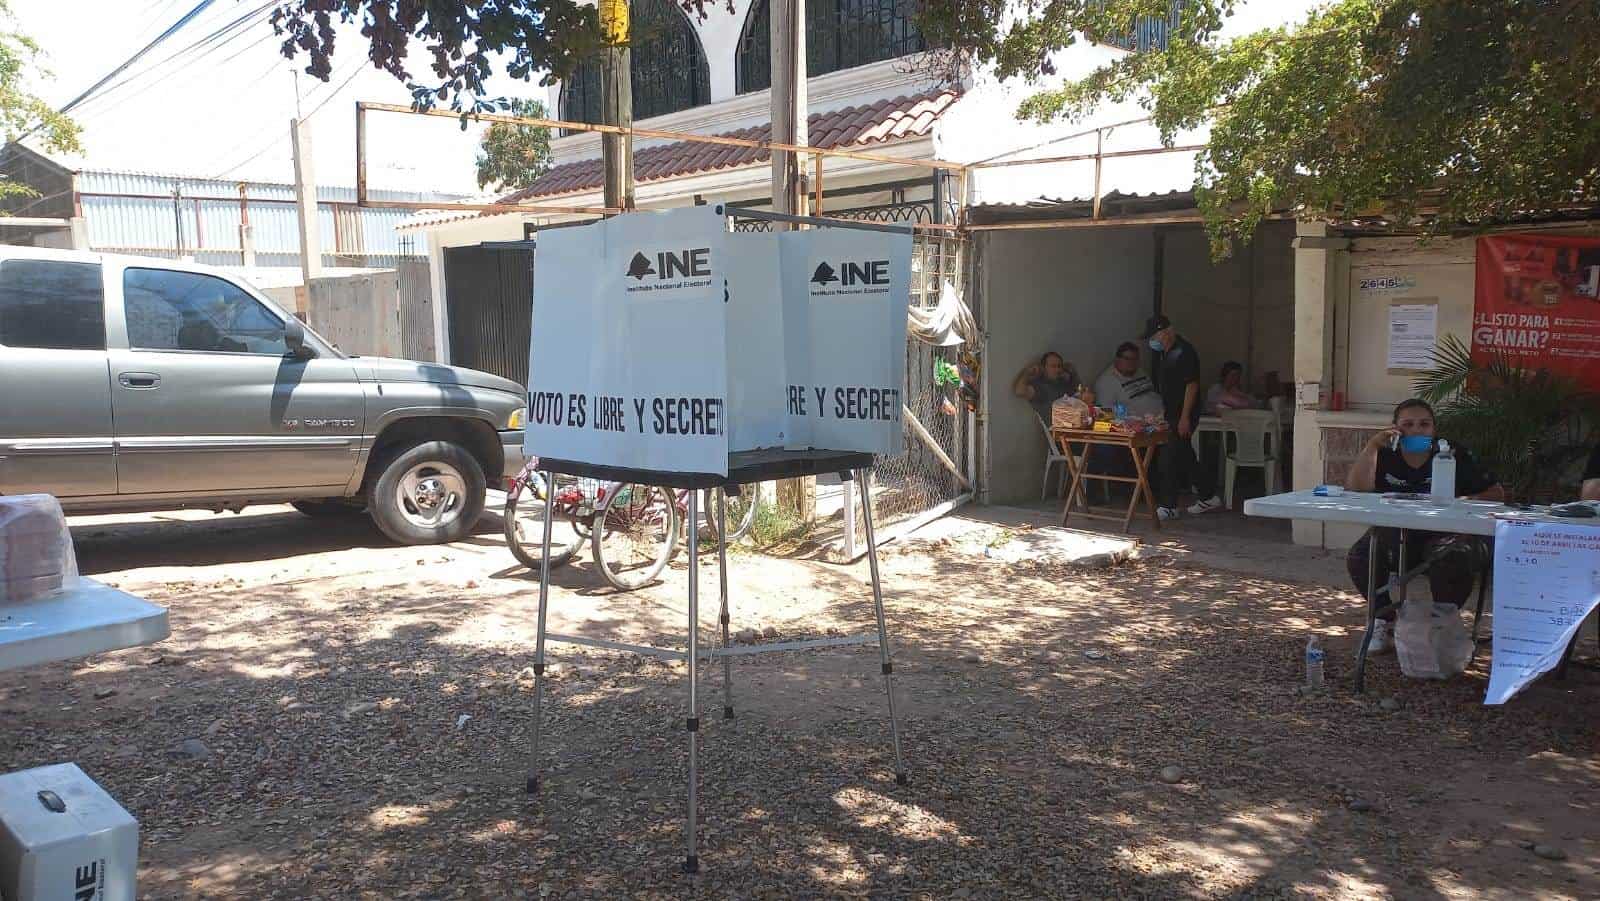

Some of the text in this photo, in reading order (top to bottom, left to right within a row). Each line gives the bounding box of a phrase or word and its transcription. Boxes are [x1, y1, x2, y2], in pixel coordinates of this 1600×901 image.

[658, 248, 711, 279] INE
[841, 260, 890, 286] INE
[684, 279, 712, 288] Electoral
[1520, 314, 1549, 328] PARA
[1473, 327, 1550, 348] GANAR?
[528, 391, 563, 426] VOTO
[567, 393, 587, 428] ES
[593, 396, 626, 432] LIBRE
[633, 398, 646, 433] Y
[786, 385, 807, 415] RE
[815, 387, 826, 418] Y
